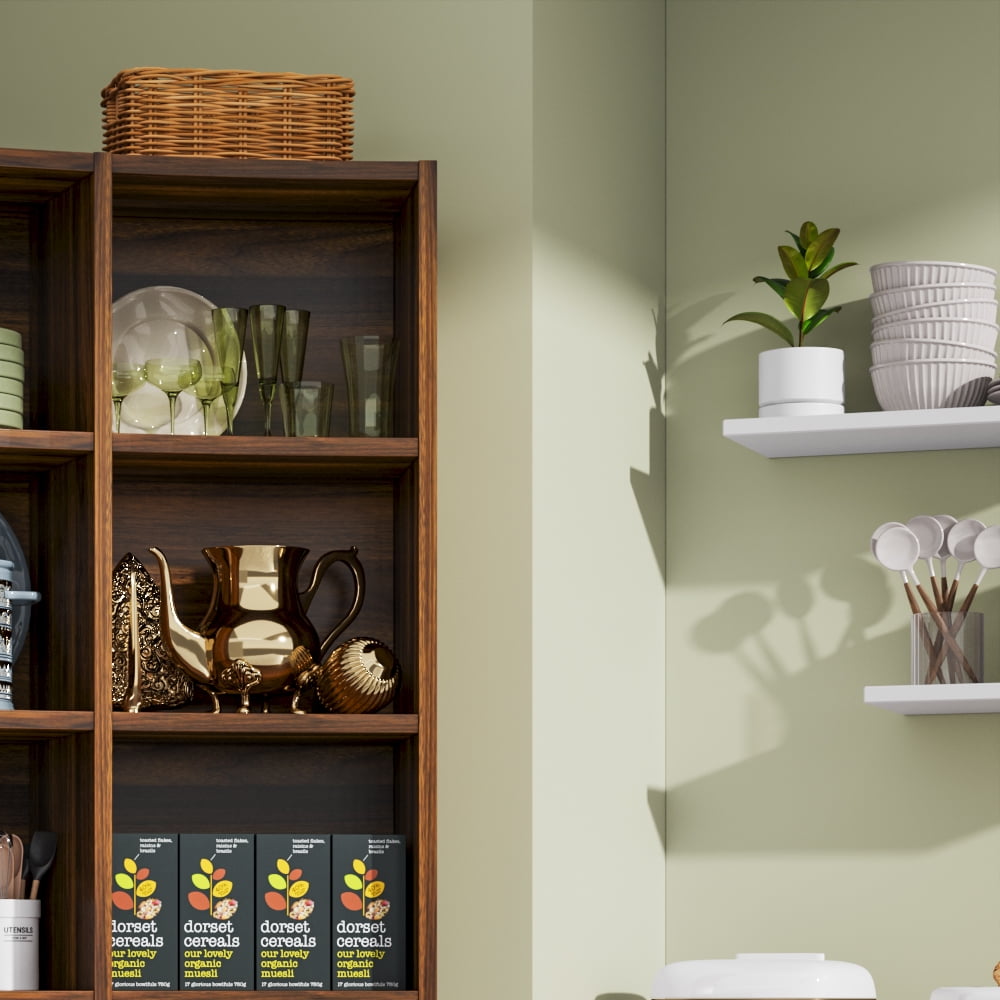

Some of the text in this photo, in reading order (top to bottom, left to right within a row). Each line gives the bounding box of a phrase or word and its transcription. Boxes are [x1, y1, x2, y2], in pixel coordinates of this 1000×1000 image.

[184, 920, 234, 933] dorset
[260, 920, 310, 934] dorset
[336, 920, 386, 934] dorset
[184, 934, 240, 948] cereals
[260, 934, 316, 948] cereals
[336, 934, 392, 948] cereals
[128, 950, 156, 960] lovely
[184, 950, 233, 960] our lovely
[261, 950, 310, 960] our lovely
[337, 950, 385, 960] our lovely
[184, 960, 222, 969] organic
[261, 960, 298, 969] organic
[337, 960, 374, 969] organic
[184, 969, 218, 978] muesli
[261, 969, 294, 978] muesli
[337, 969, 370, 978] muesli
